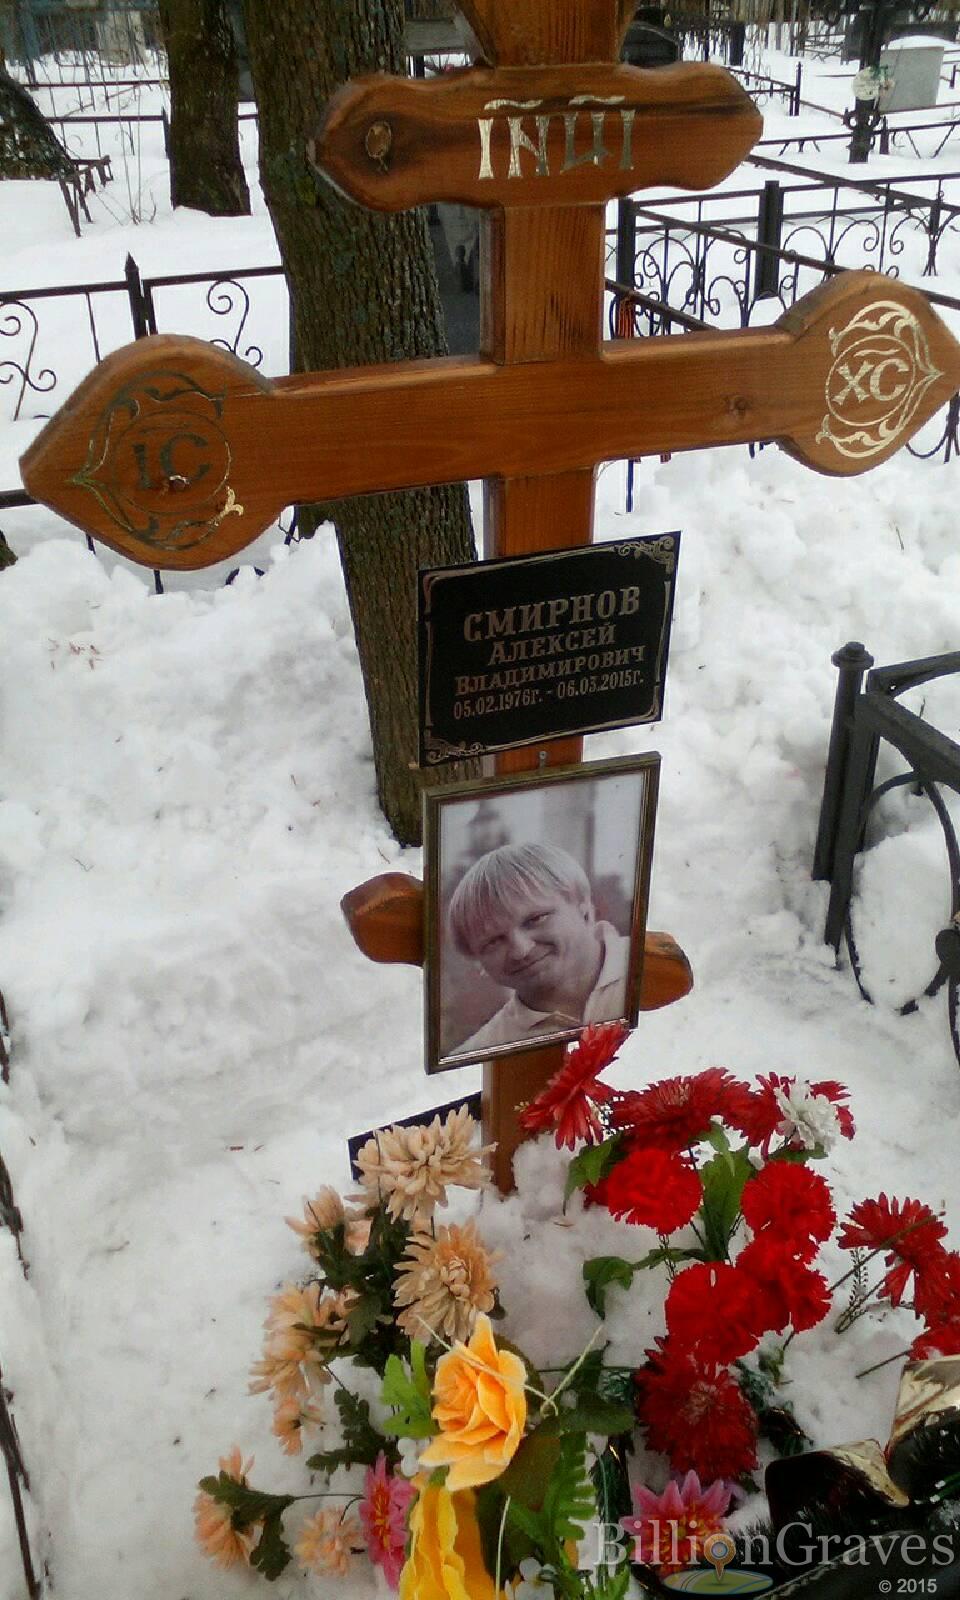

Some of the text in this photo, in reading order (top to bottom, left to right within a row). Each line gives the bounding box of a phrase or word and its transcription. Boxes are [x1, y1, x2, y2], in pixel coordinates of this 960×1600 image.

[463, 586, 640, 642] СМИРНОВ
[487, 622, 617, 666] АЛЕКСЕЙ
[454, 645, 646, 696] ВЛАДИМИРОВИЧ
